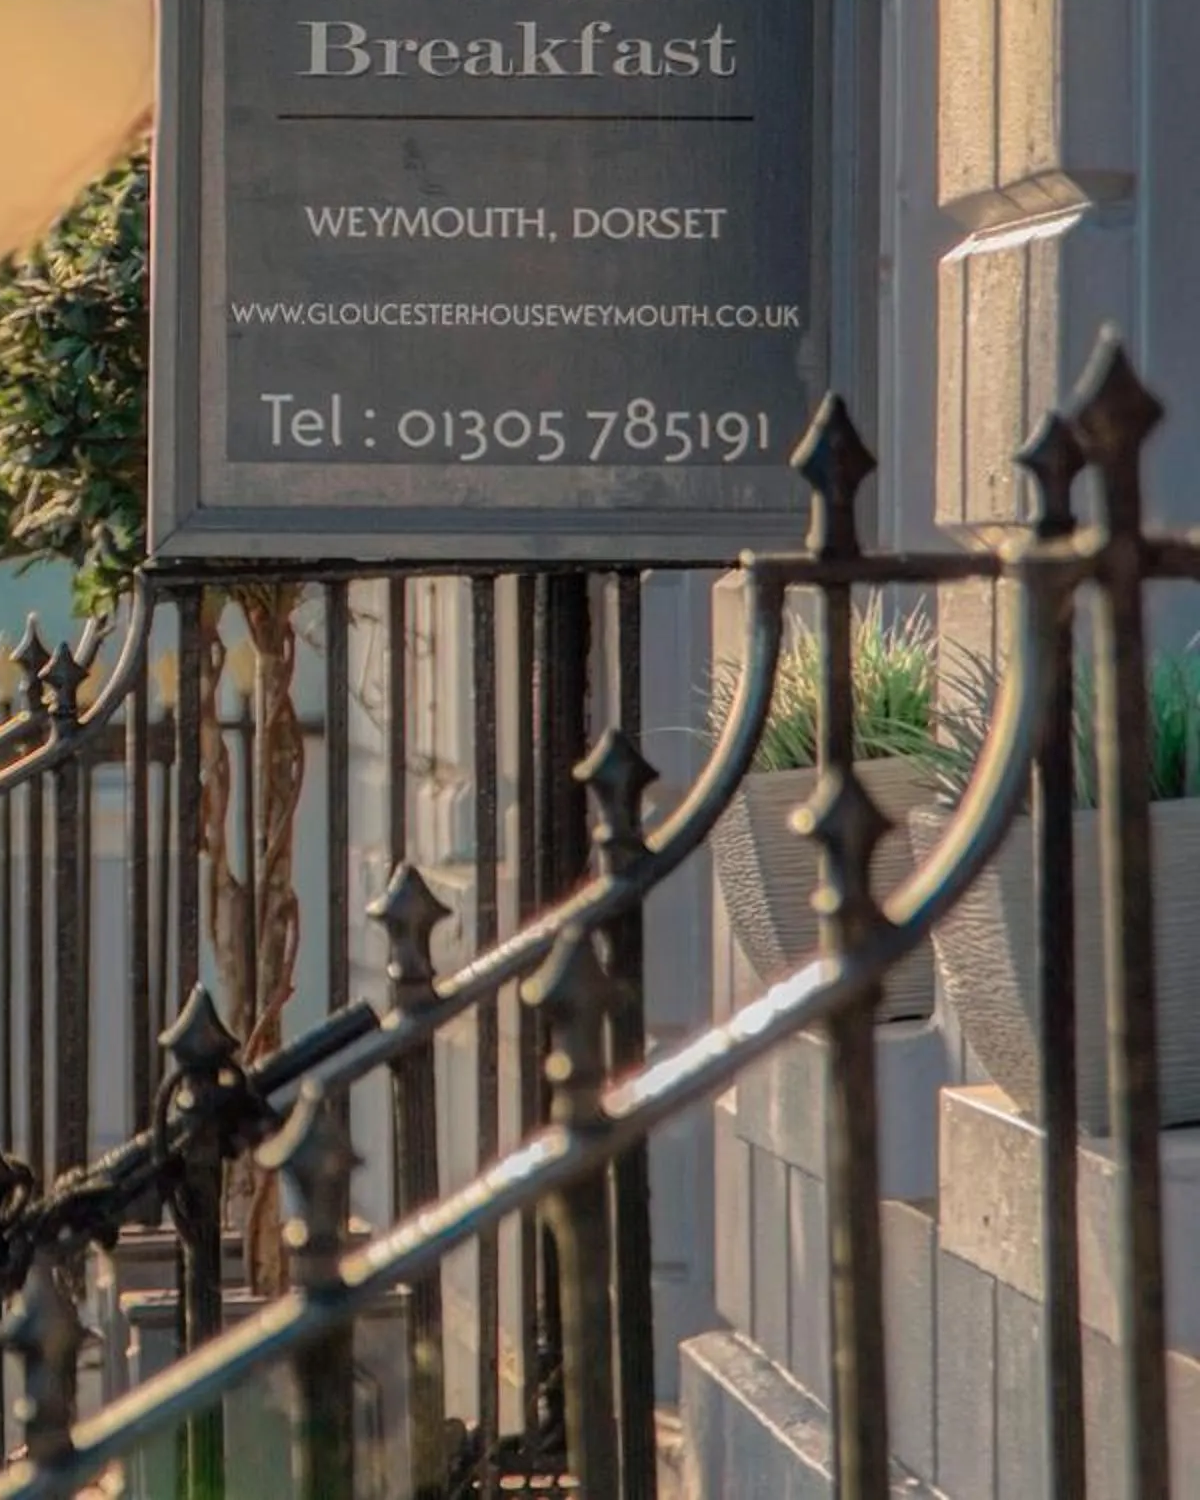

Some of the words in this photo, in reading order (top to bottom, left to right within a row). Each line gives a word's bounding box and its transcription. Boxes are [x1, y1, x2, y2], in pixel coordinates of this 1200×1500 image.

[297, 21, 737, 78] Breakfast
[304, 206, 557, 243] WEYMOUTH,
[572, 207, 728, 240] DORSET
[231, 302, 799, 328] WWW.GLOUCESTERHOUSEWEYMOUTH.CO.UK
[260, 393, 343, 448] Tel
[397, 409, 566, 463] 01305
[585, 397, 770, 463] 785191
